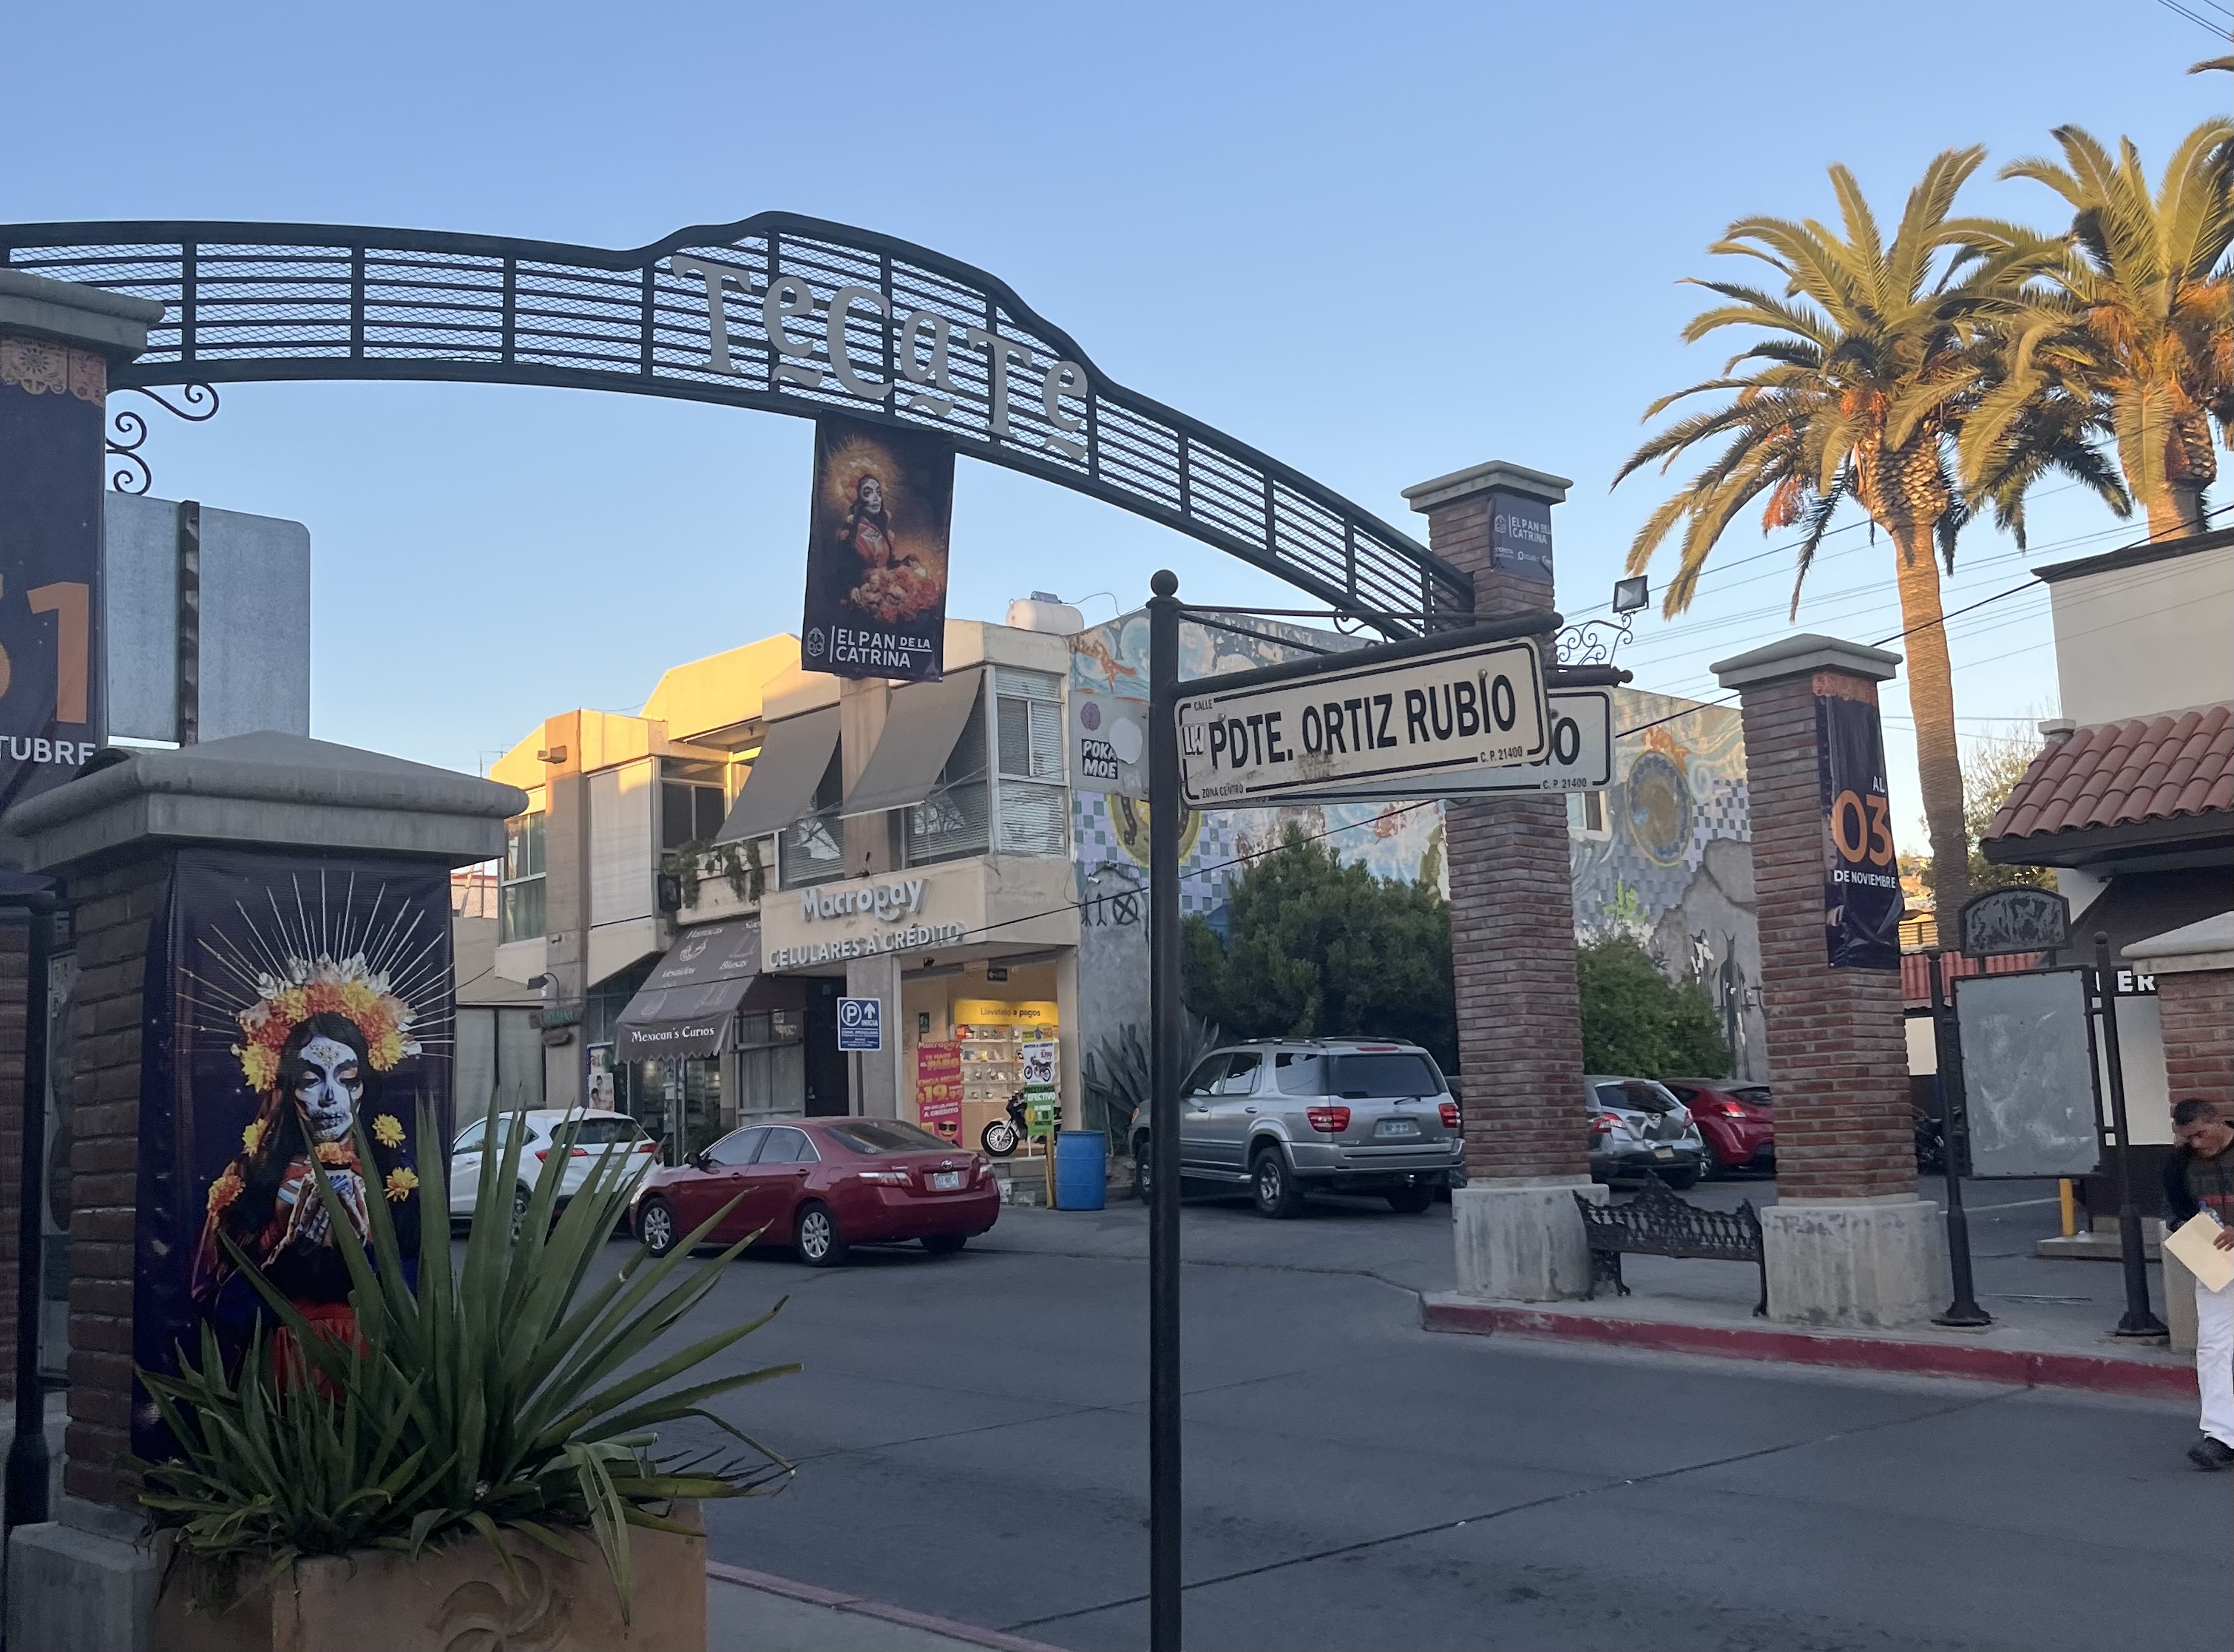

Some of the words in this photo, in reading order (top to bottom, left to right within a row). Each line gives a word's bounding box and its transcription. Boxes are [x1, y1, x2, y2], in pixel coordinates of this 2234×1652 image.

[1512, 516, 1521, 528] EL
[1522, 519, 1540, 532] PAN
[1512, 527, 1548, 545] CATRINA
[836, 628, 856, 646] EL
[859, 630, 896, 651] PAN
[900, 636, 915, 649] DE
[917, 637, 931, 649] LA
[836, 646, 912, 668] CATRINA
[1194, 699, 1214, 711] CALLE
[1208, 711, 1293, 771] PDTE.
[1302, 693, 1398, 756] ORTIZ
[1498, 745, 1523, 761] 21400
[1083, 758, 1117, 779] MOE
[1561, 777, 1588, 789] 21400
[1872, 776, 1886, 793] AL
[1202, 787, 1219, 799] ZONA
[1830, 789, 1893, 867] 03
[1833, 870, 1850, 883] DE
[1851, 871, 1896, 889] NOVIEMBRE
[800, 878, 924, 921] Macropay
[769, 938, 861, 968] CELULARES
[865, 934, 878, 953] A
[846, 1005, 858, 1023] P
[1019, 1009, 1041, 1019] pagos
[631, 1026, 680, 1043] Mexican's
[682, 1025, 715, 1037] Curios
